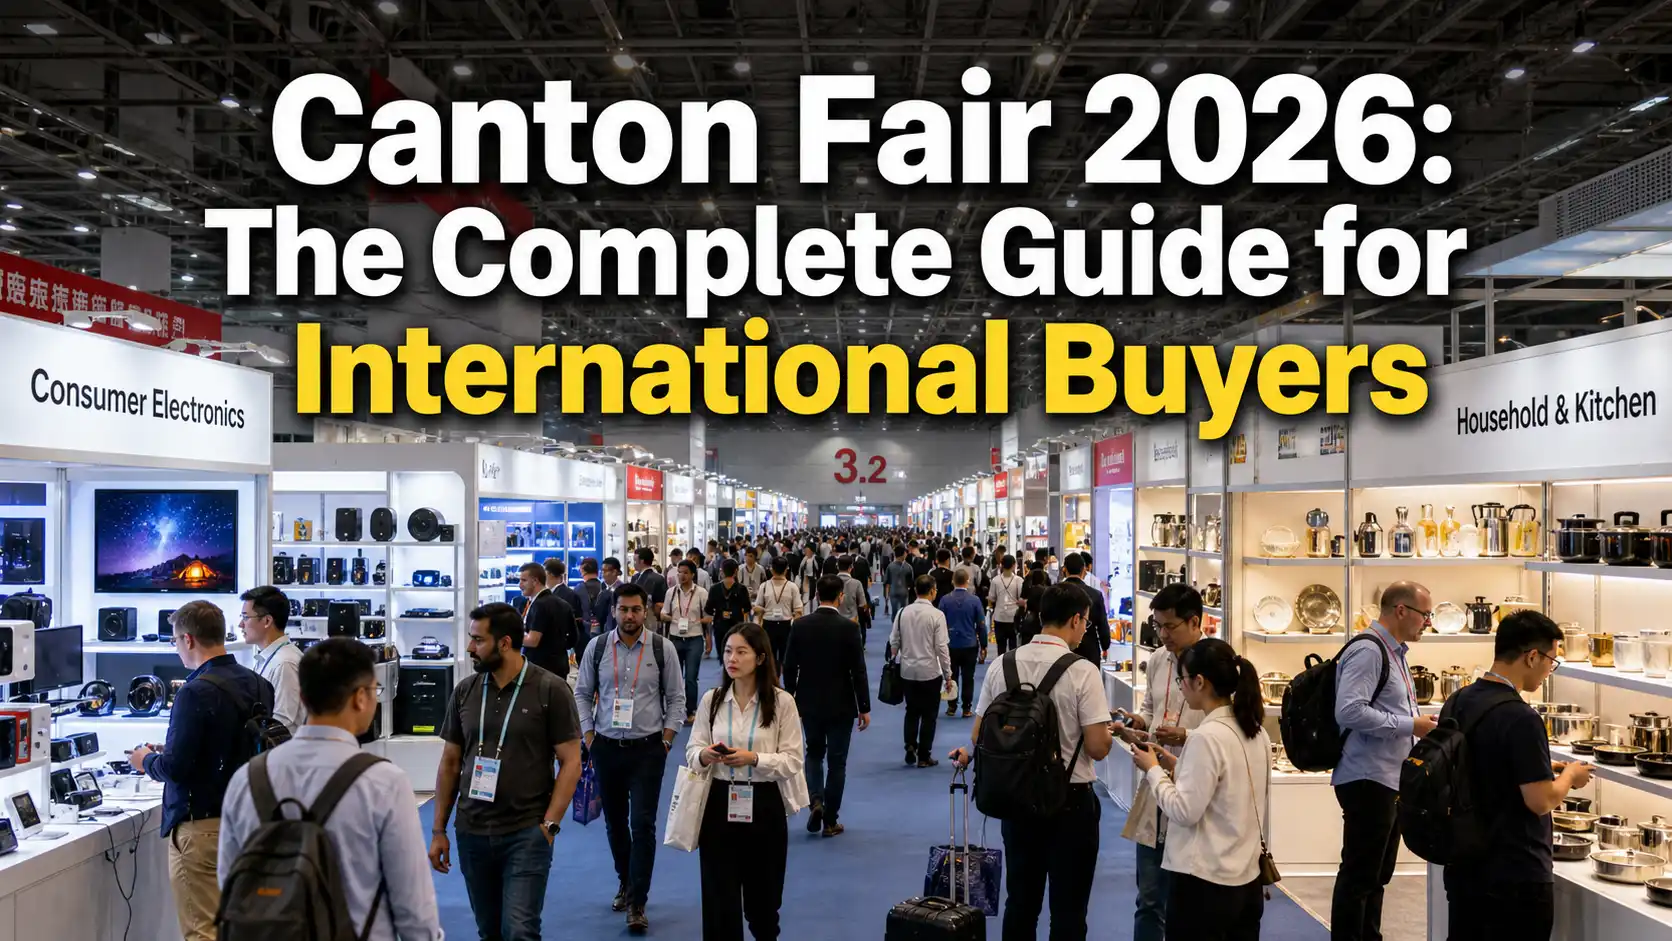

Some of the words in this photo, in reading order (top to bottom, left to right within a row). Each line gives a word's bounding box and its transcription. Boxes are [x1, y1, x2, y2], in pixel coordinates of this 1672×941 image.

[31, 368, 148, 416] Consumer
[152, 388, 245, 429] Electronics
[1457, 394, 1549, 436] Household
[1554, 394, 1570, 426] &
[1576, 386, 1657, 423] Kitchen
[834, 448, 887, 484] 3.2
